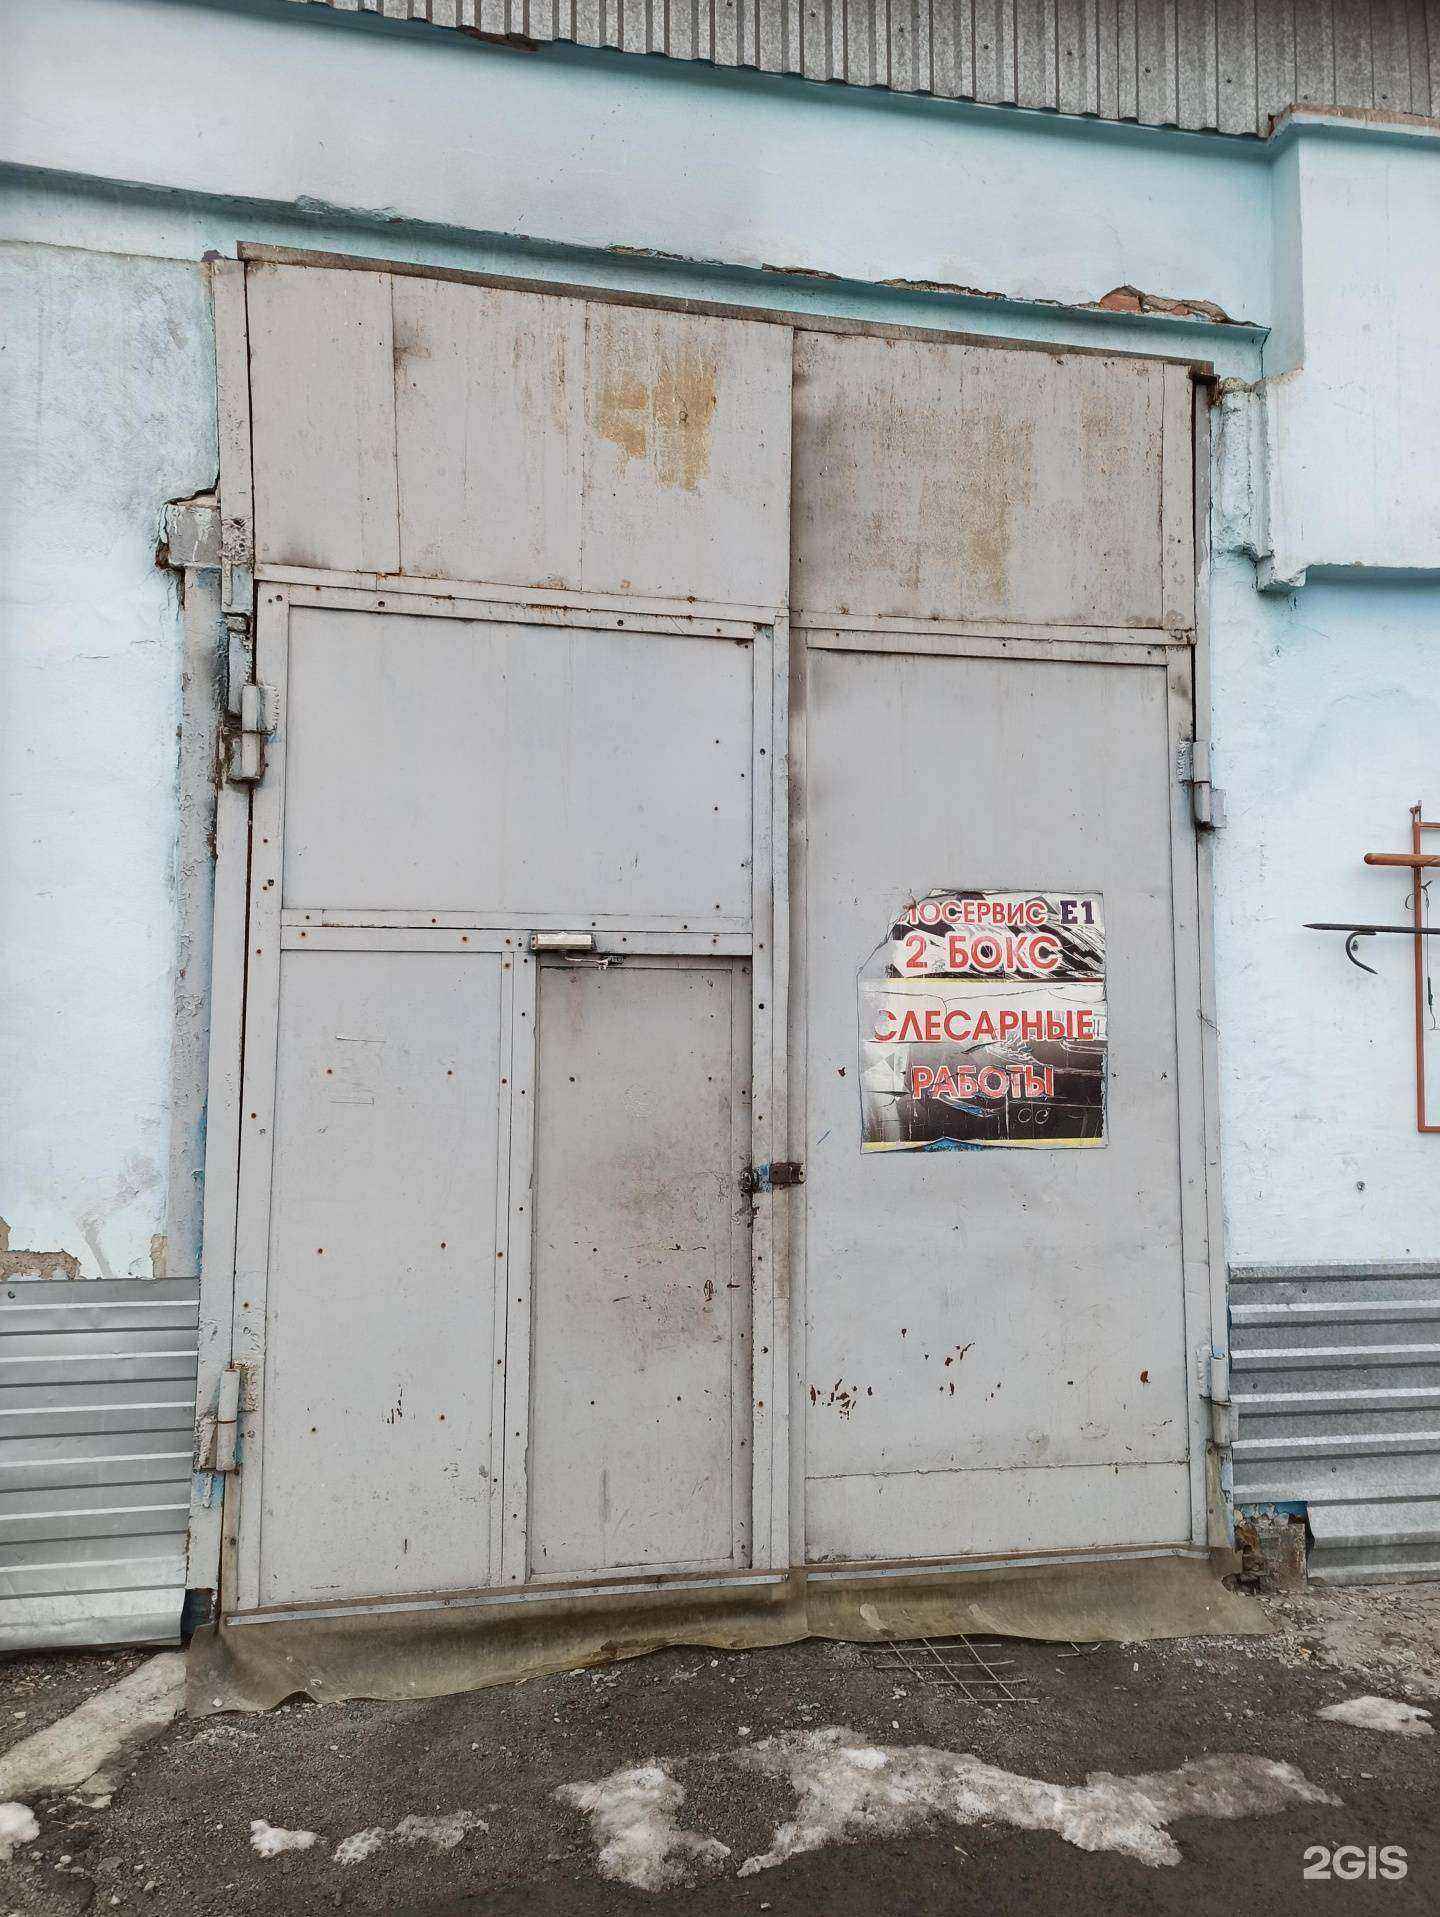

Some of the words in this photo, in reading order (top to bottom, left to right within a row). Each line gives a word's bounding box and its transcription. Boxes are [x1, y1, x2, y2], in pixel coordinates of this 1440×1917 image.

[905, 934, 928, 969] 2
[948, 934, 1060, 970] БОКС
[874, 1009, 1095, 1041] СЛЕСАРНЫЕ
[912, 1064, 1054, 1099] РАБОТЫ
